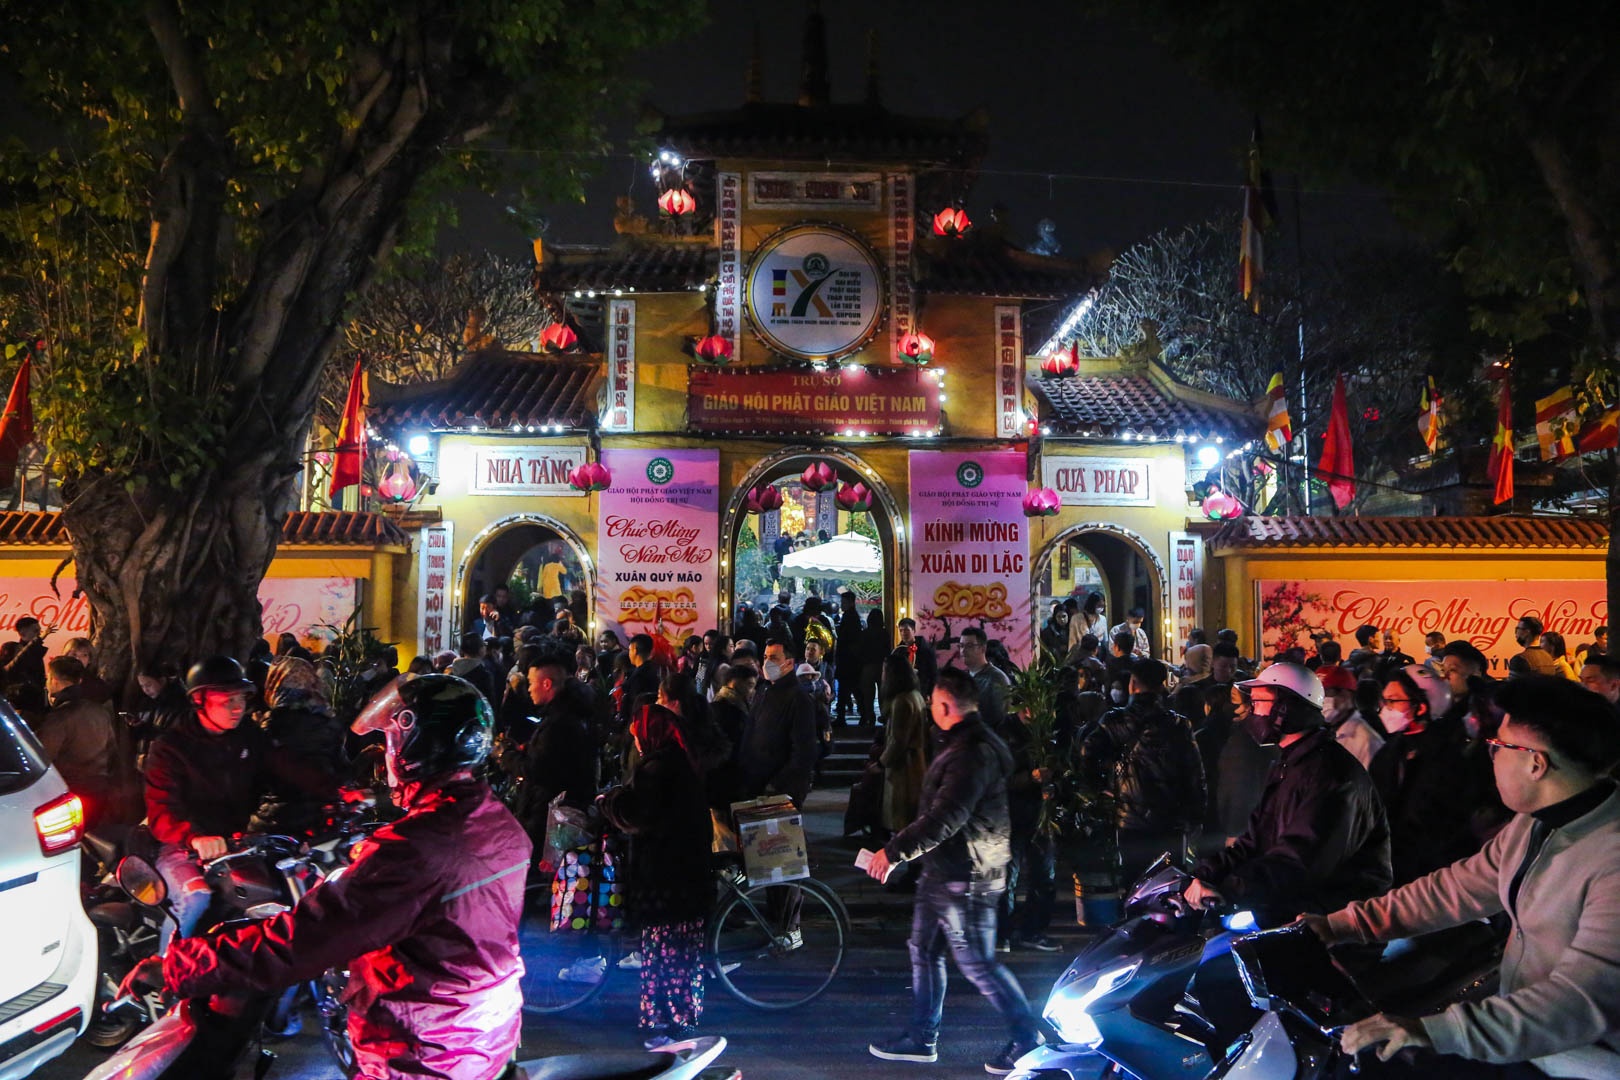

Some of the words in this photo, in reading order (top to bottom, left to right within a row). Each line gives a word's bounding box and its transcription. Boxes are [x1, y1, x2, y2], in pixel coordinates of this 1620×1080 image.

[792, 376, 818, 388] TRỤ
[703, 390, 738, 410] GIÁO
[744, 392, 768, 413] HỘI
[772, 392, 811, 413] PHẬT
[814, 392, 850, 411] GIÁO
[855, 393, 886, 414] VIỆT
[891, 396, 926, 412] NAM
[528, 456, 573, 484] TĂNG
[1094, 468, 1139, 494] PHÁP
[608, 487, 624, 495] GIÁO
[626, 487, 639, 495] HỘI
[641, 487, 658, 495] PHẬT
[660, 487, 678, 495] GIÁO
[679, 487, 695, 495] VIỆT
[697, 487, 712, 495] NAM
[606, 515, 648, 538] Chúc
[648, 520, 700, 546] Mừng
[925, 518, 964, 542] KÍNH
[970, 518, 1018, 542] MỪNG
[665, 546, 712, 564] Mới
[921, 550, 966, 573] XUÂN
[972, 554, 987, 573] DI
[993, 550, 1023, 577] LẶC
[616, 570, 646, 582] XUÂN
[650, 570, 674, 582] QUÝ
[677, 570, 702, 582] MÃO
[933, 581, 1012, 618] 2023
[1333, 590, 1413, 635] Chúc
[1412, 598, 1510, 651] Mừng
